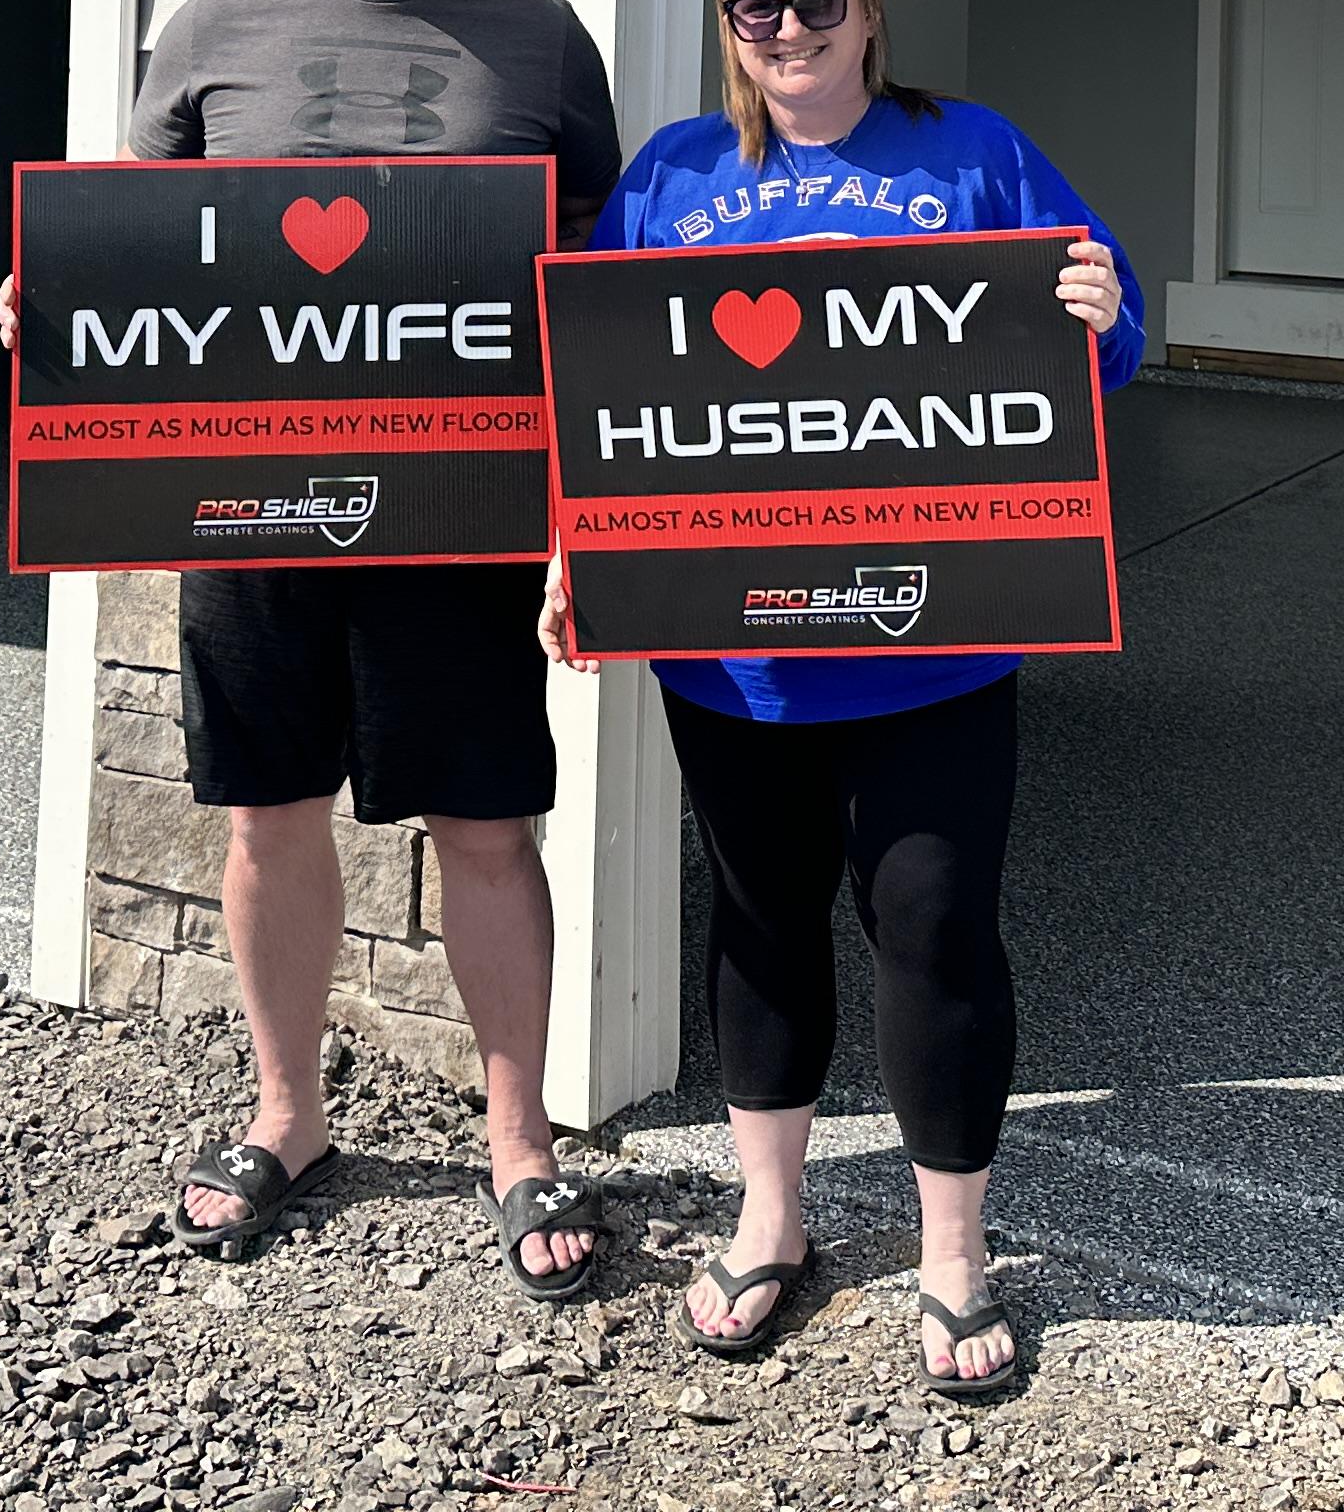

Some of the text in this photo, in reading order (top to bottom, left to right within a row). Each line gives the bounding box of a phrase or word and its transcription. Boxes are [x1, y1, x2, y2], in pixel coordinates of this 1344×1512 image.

[200, 205, 216, 265] I
[672, 175, 948, 244] BUFFALO
[72, 301, 513, 368] MY WIFE
[667, 281, 989, 356] I MY
[27, 410, 541, 442] ALMOST AS MUCH AS MY NEW FLOOR!
[597, 390, 1055, 460] HUSBAND
[193, 525, 316, 536] CONCRETE COATINGS
[573, 497, 1093, 533] ALMOST AS MUCH AS MY NEW FLOOR!
[743, 615, 866, 626] CONCRETE COATINGS
